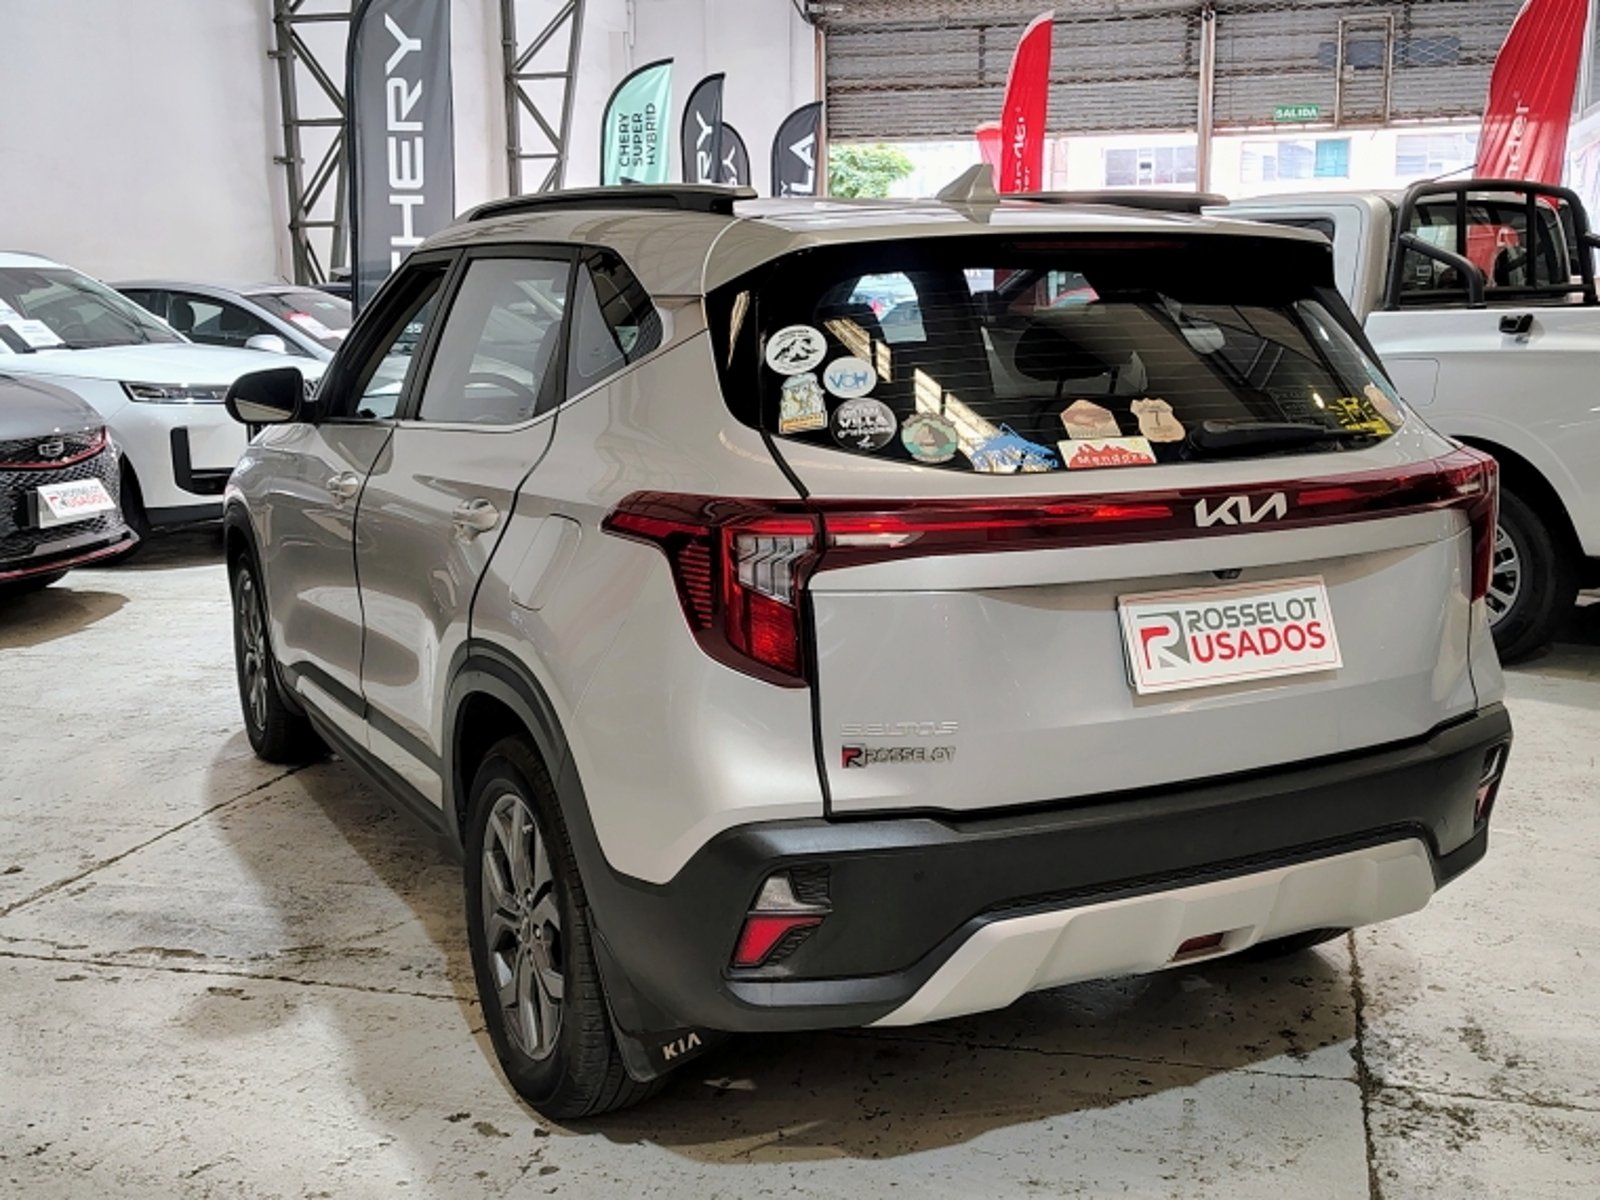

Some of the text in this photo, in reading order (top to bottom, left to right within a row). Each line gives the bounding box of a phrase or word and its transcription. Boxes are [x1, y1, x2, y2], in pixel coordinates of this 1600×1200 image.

[1275, 108, 1318, 119] SALIDA
[618, 112, 630, 167] CHERY
[632, 112, 643, 167] SUPER
[645, 102, 656, 166] HYBRID
[1194, 492, 1288, 527] KIA
[1185, 597, 1317, 633] ROSSELOT
[1190, 622, 1327, 664] USADOS
[841, 721, 959, 737] SELTOS
[662, 1032, 702, 1060] KIA
